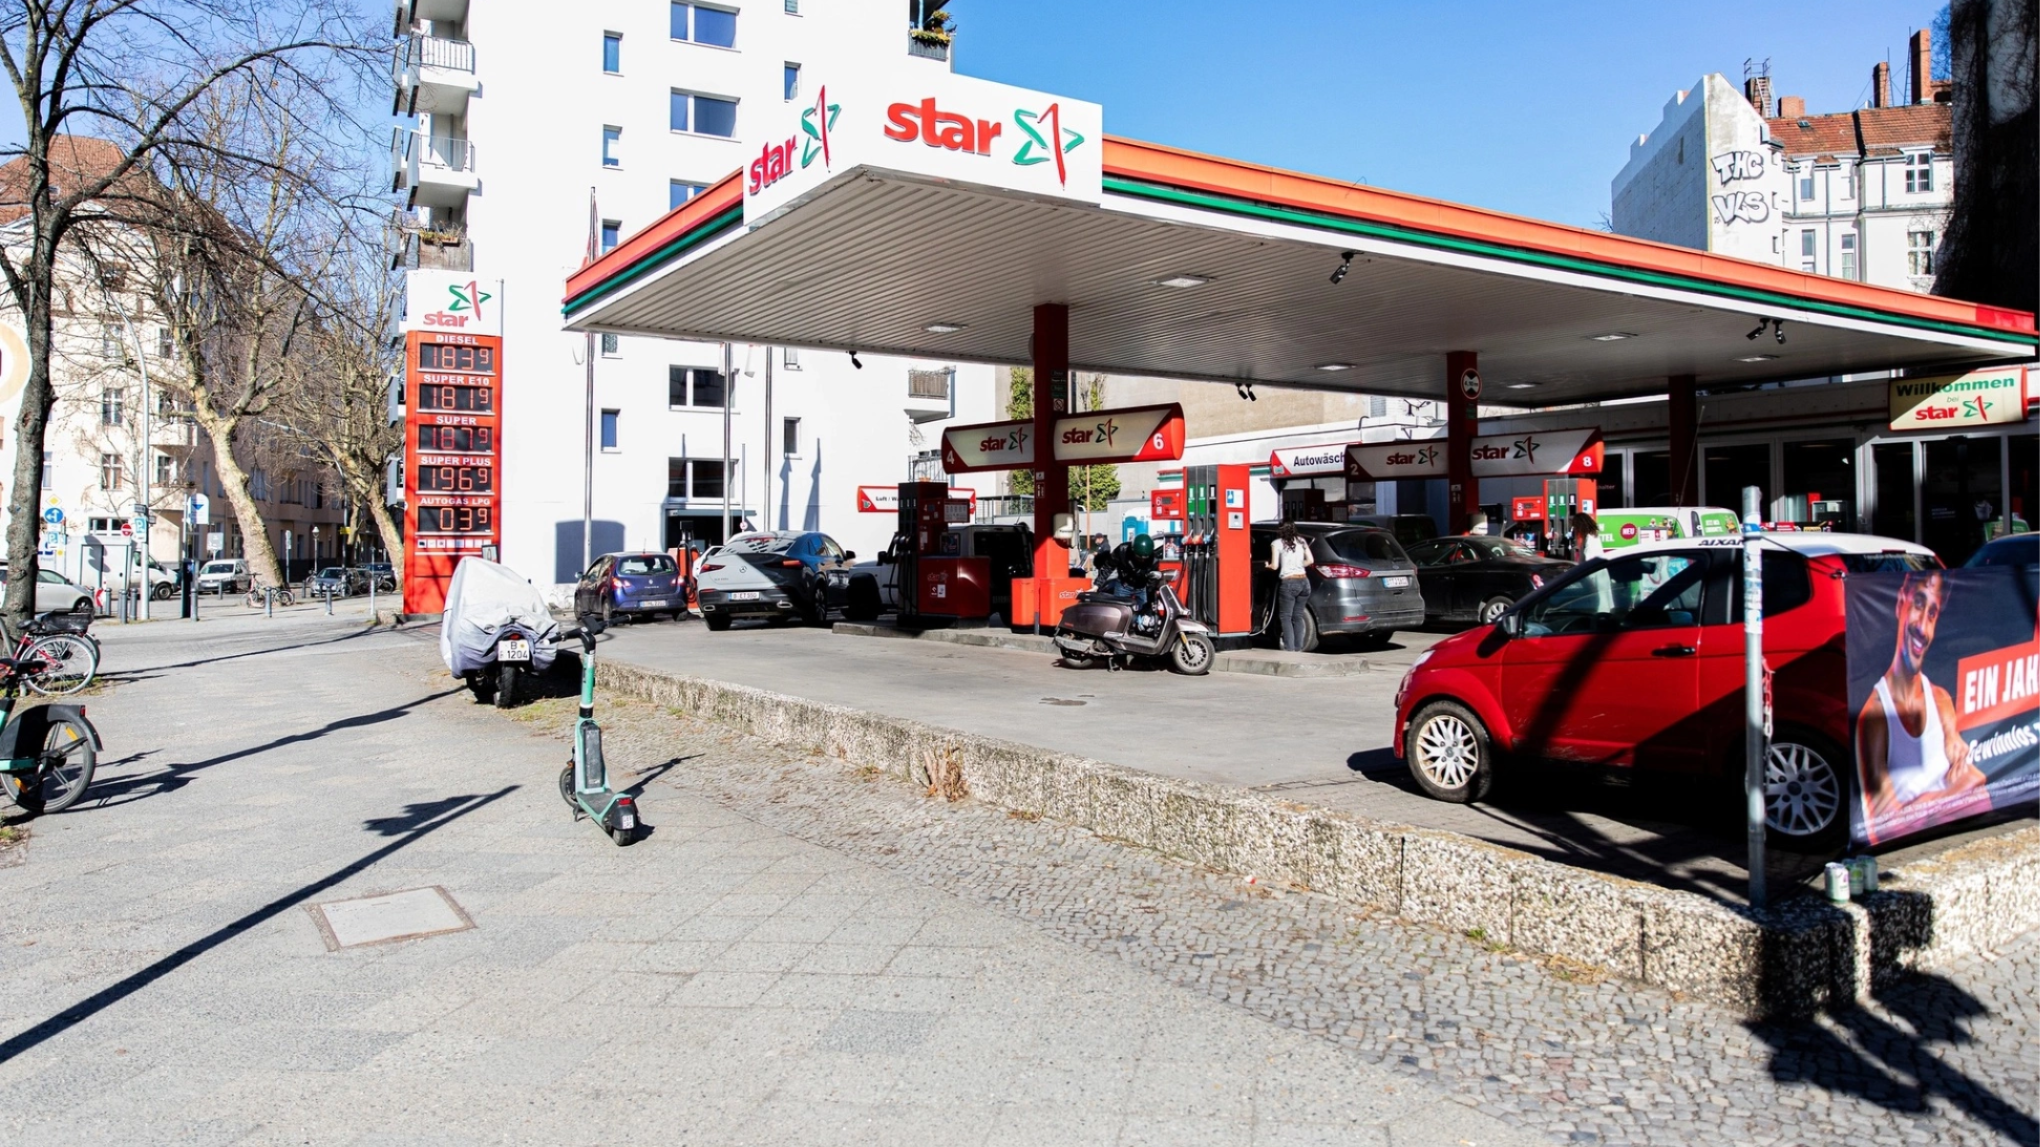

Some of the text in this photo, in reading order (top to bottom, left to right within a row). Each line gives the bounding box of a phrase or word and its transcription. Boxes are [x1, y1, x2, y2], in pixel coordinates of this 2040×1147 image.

[884, 97, 1002, 157] star
[749, 135, 797, 196] star
[423, 310, 469, 328] star
[436, 335, 479, 345] DIESEL
[423, 374, 490, 386] SUPER E10
[1896, 377, 2015, 397] Willkommen
[436, 415, 477, 425] SUPER
[1915, 406, 1958, 421] star
[1062, 427, 1094, 445] star
[1152, 433, 1165, 450] 6
[980, 436, 1007, 452] star
[946, 450, 955, 465] 4
[1386, 452, 1416, 466] star
[1471, 444, 1510, 460] star
[421, 456, 491, 466] SUPER PLUS
[1583, 456, 1593, 467] 8
[1350, 464, 1359, 475] 2
[420, 497, 491, 506] AUTOGAS LPG
[507, 651, 528, 659] 1204
[1964, 664, 1999, 714] EIN
[1966, 725, 2038, 764] Gewinnlos
